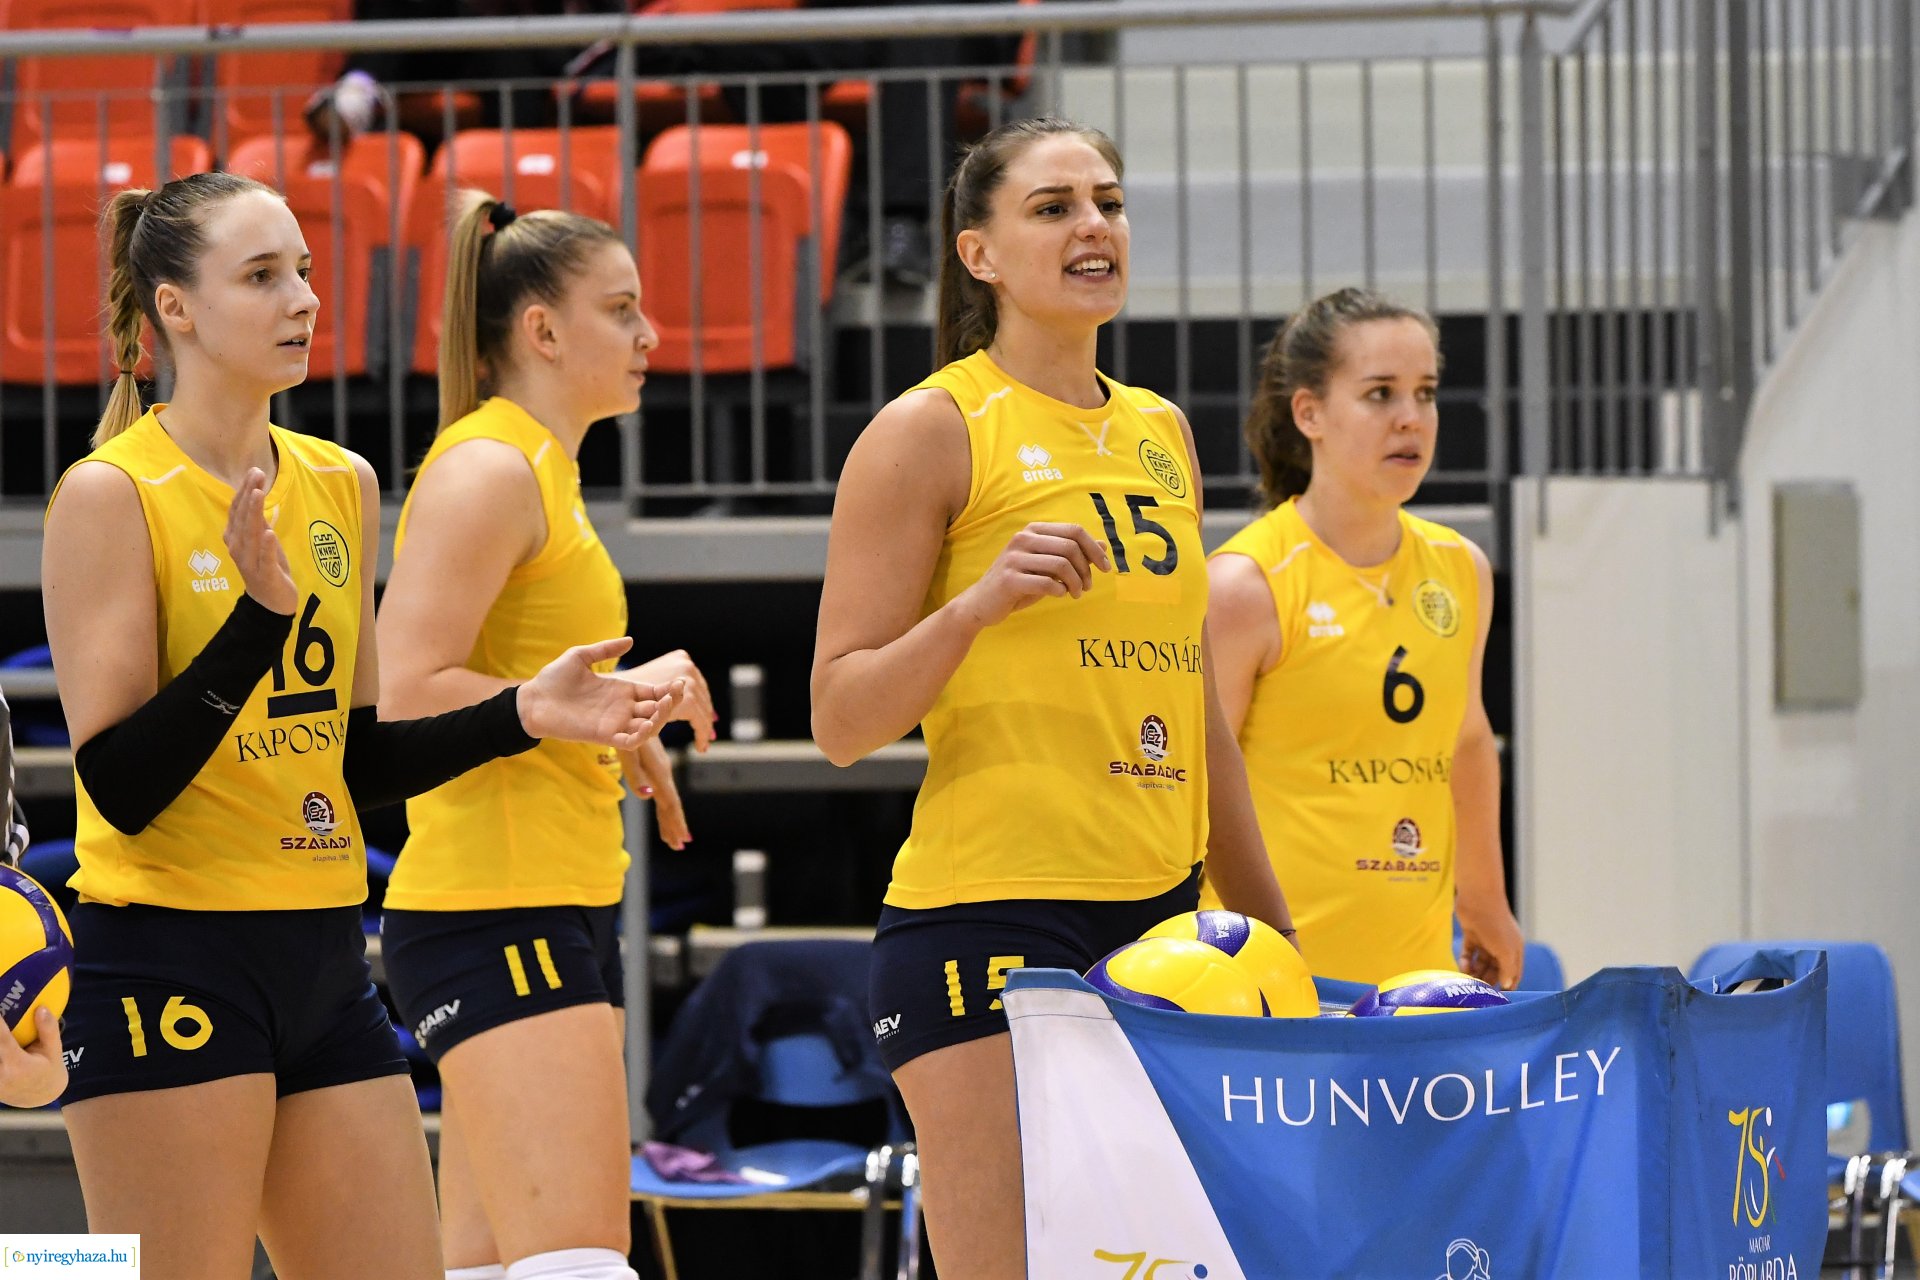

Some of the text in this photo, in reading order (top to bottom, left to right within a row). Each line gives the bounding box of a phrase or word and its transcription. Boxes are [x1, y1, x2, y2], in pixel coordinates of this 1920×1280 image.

[1023, 467, 1064, 483] errea
[1089, 492, 1178, 576] 15
[191, 577, 230, 593] errea
[1383, 645, 1425, 724] 6
[504, 938, 562, 997] 11
[121, 996, 213, 1058] 16
[1222, 1047, 1621, 1127] HUNVOLLEY
